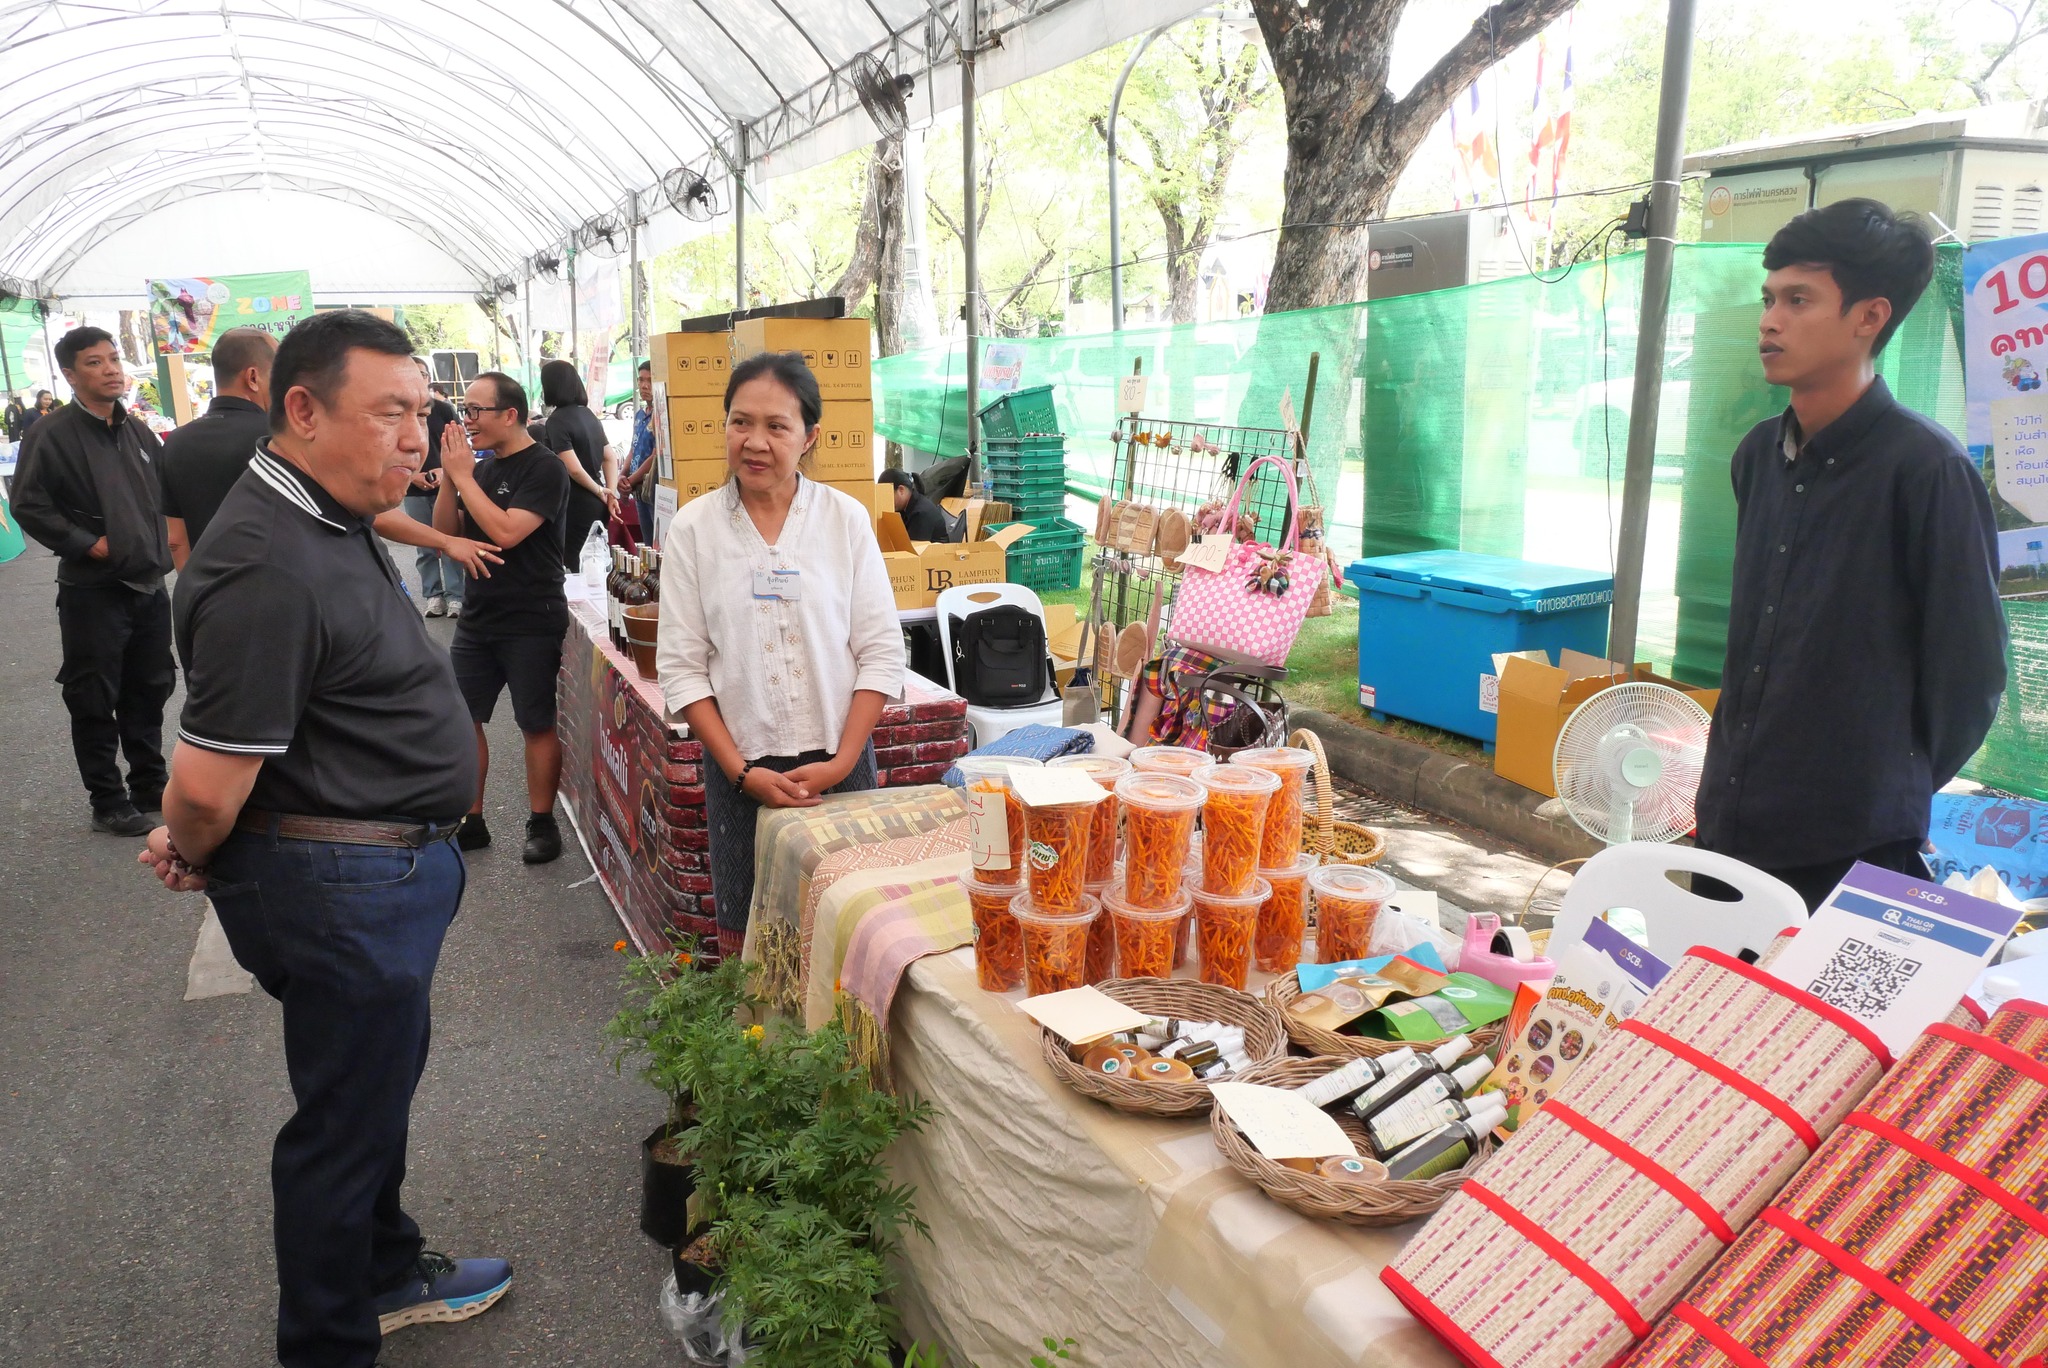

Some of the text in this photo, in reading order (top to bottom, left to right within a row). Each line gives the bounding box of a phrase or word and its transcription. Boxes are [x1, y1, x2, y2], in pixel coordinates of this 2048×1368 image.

[237, 296, 302, 315] ZONE
[2014, 414, 2042, 426] ไข่ไก่
[2014, 445, 2036, 456] เห็ด
[891, 575, 915, 583] PHUN
[958, 568, 1000, 578] LAMPHUN
[1918, 890, 1945, 905] SCB
[1901, 920, 1932, 934] PAYMENT
[1906, 915, 1935, 930] THAI QR
[1625, 951, 1642, 967] SCB
